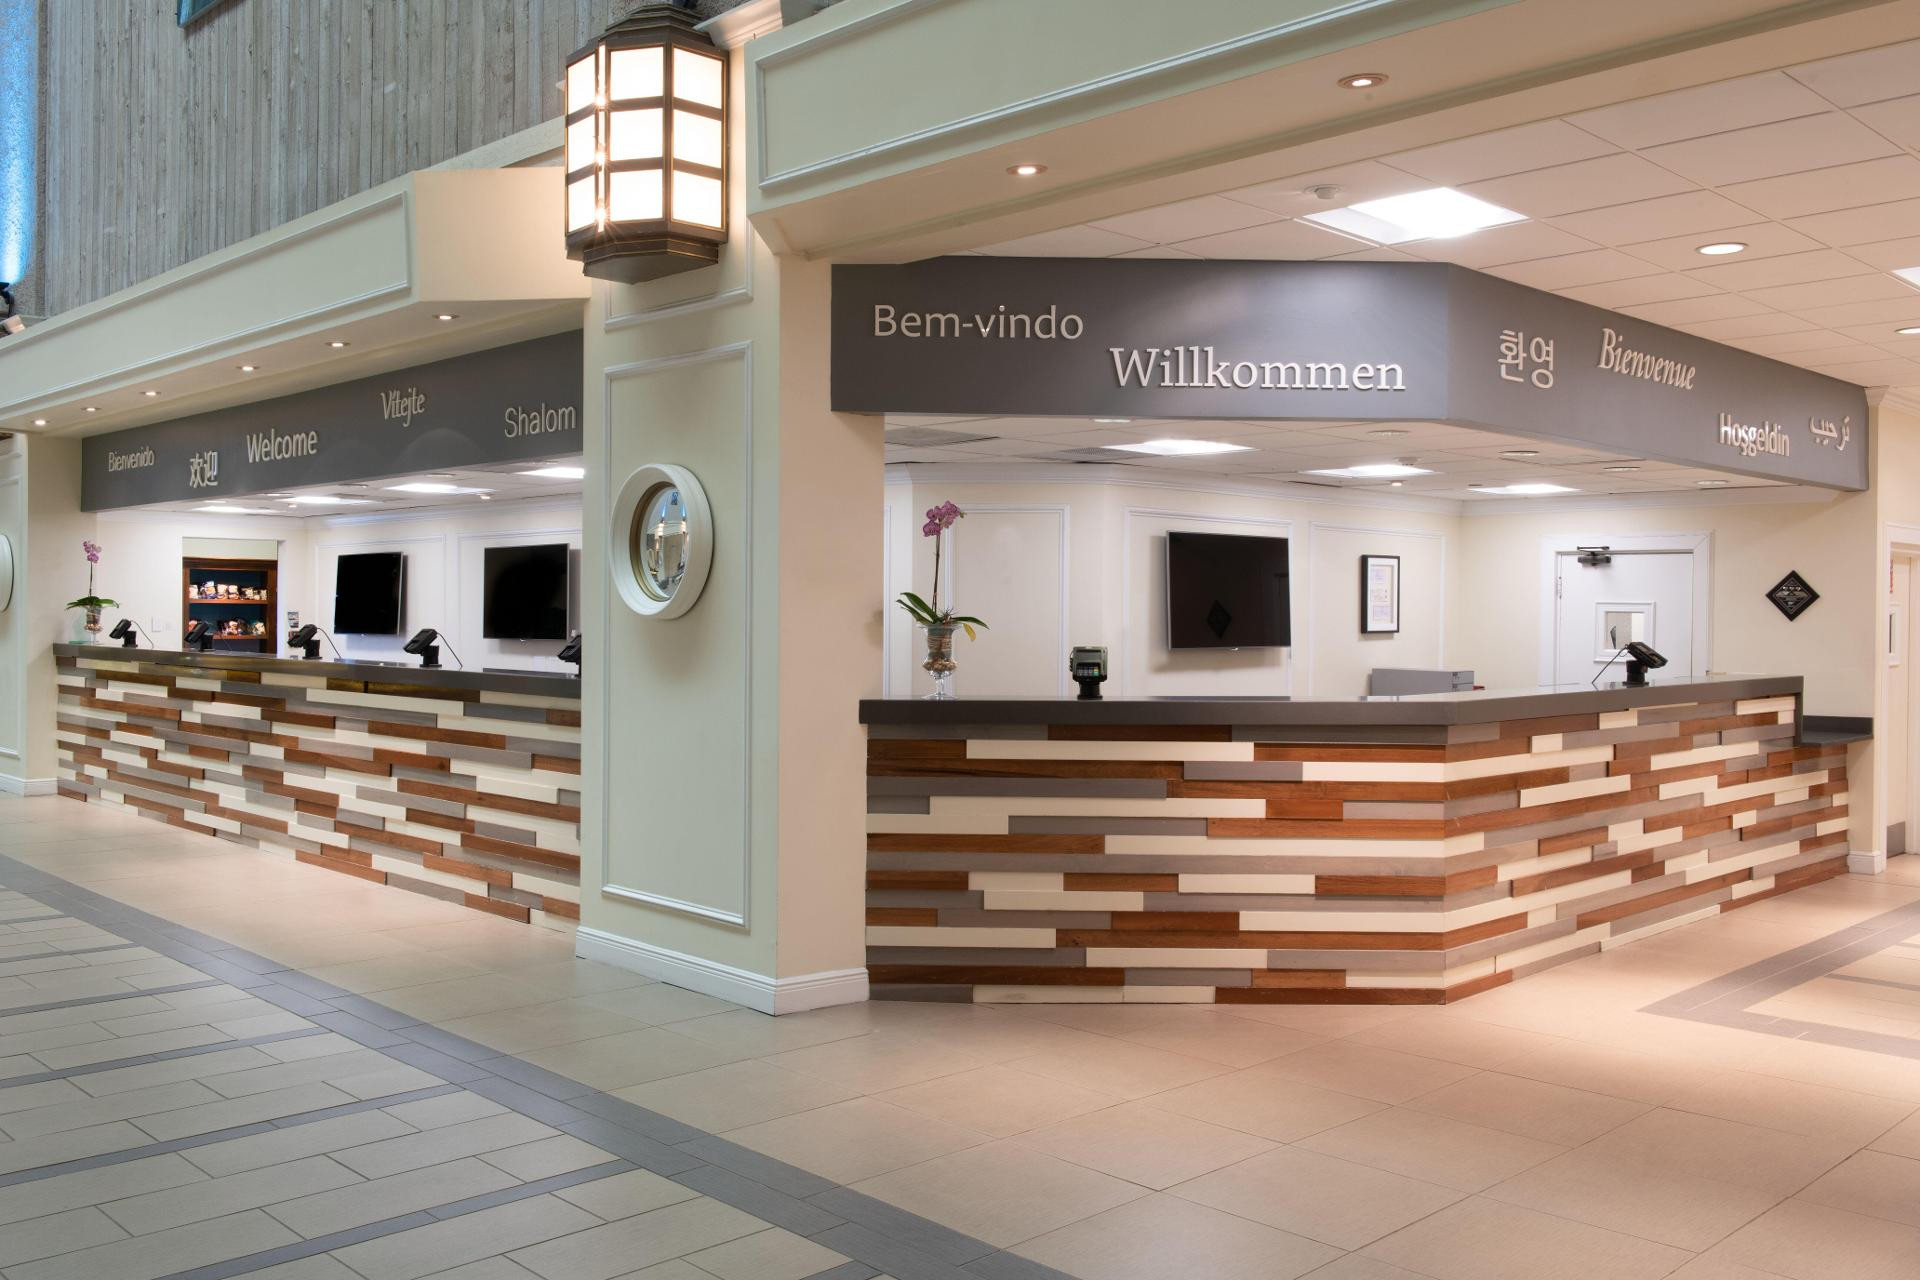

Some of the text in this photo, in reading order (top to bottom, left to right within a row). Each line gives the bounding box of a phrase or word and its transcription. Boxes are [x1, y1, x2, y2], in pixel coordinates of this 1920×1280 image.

[874, 304, 1084, 340] Bem-vindo
[1109, 346, 1406, 390] Willkommen
[1498, 329, 1554, 389] 환영
[1598, 327, 1697, 390] Bienvenue
[380, 387, 425, 427] Vítejte
[504, 402, 577, 438] Shalom
[246, 428, 318, 463] Welcome
[1719, 412, 1790, 457] Hoşgeldin
[1808, 416, 1850, 451] ترحيب
[108, 446, 155, 472] Bienvenido
[189, 451, 218, 489] 欢迎
